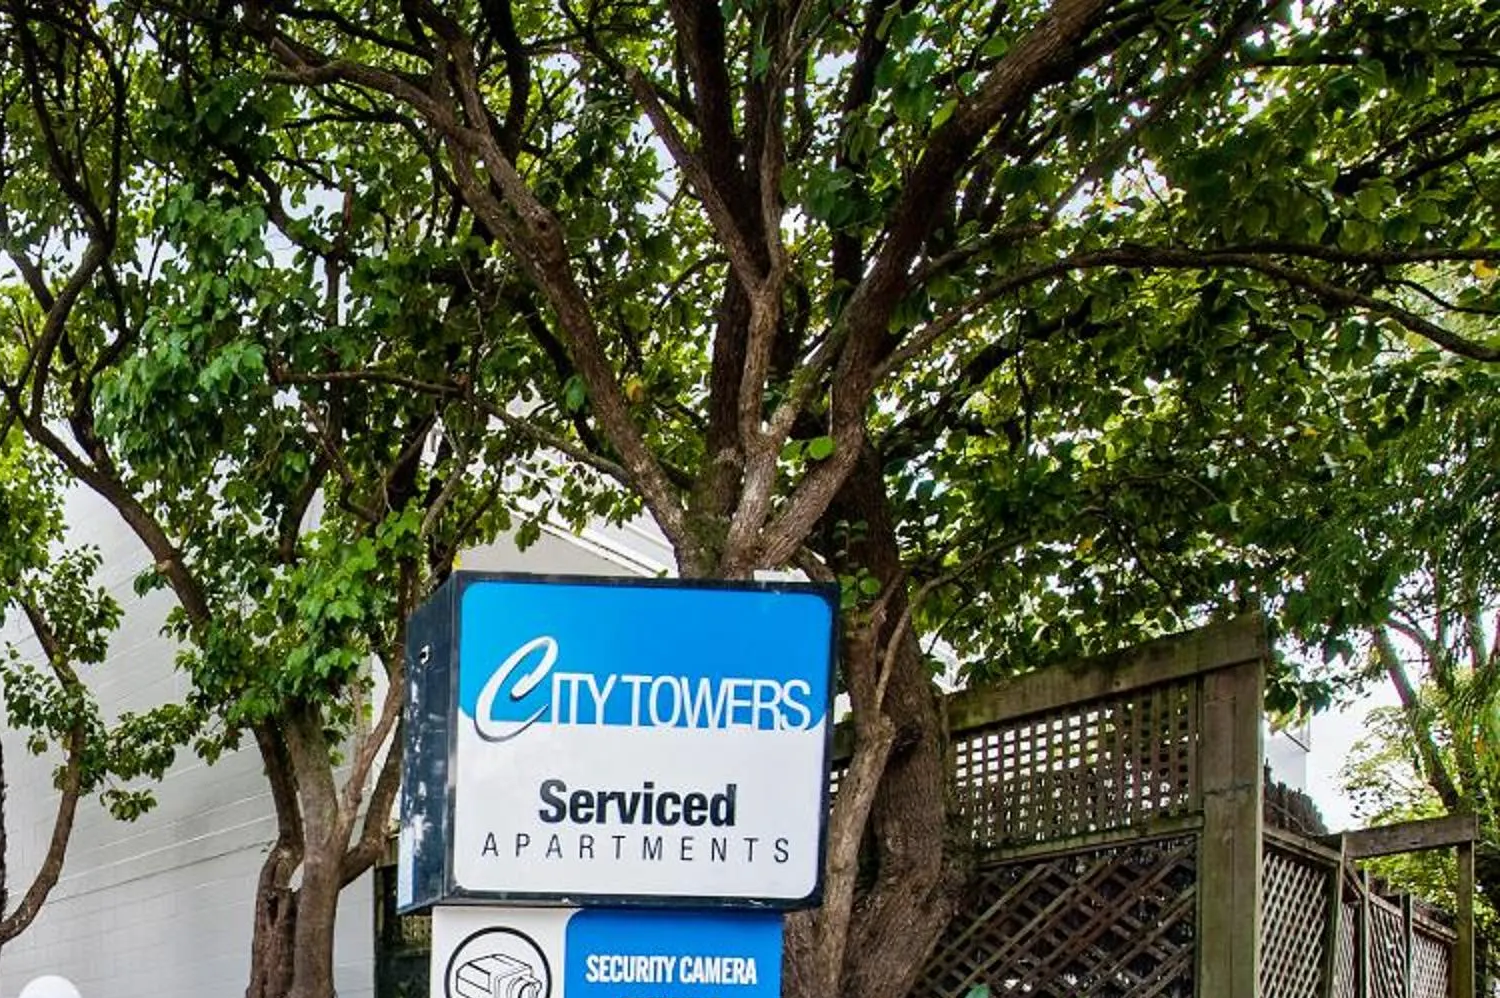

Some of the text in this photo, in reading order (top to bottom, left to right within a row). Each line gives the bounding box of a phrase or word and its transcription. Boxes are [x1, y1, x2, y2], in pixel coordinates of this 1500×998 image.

[474, 635, 811, 742] CITY TOWERS
[539, 779, 737, 827] Serviced
[481, 832, 790, 864] APARTMENTS
[586, 955, 757, 985] SECURITY CAMERA
